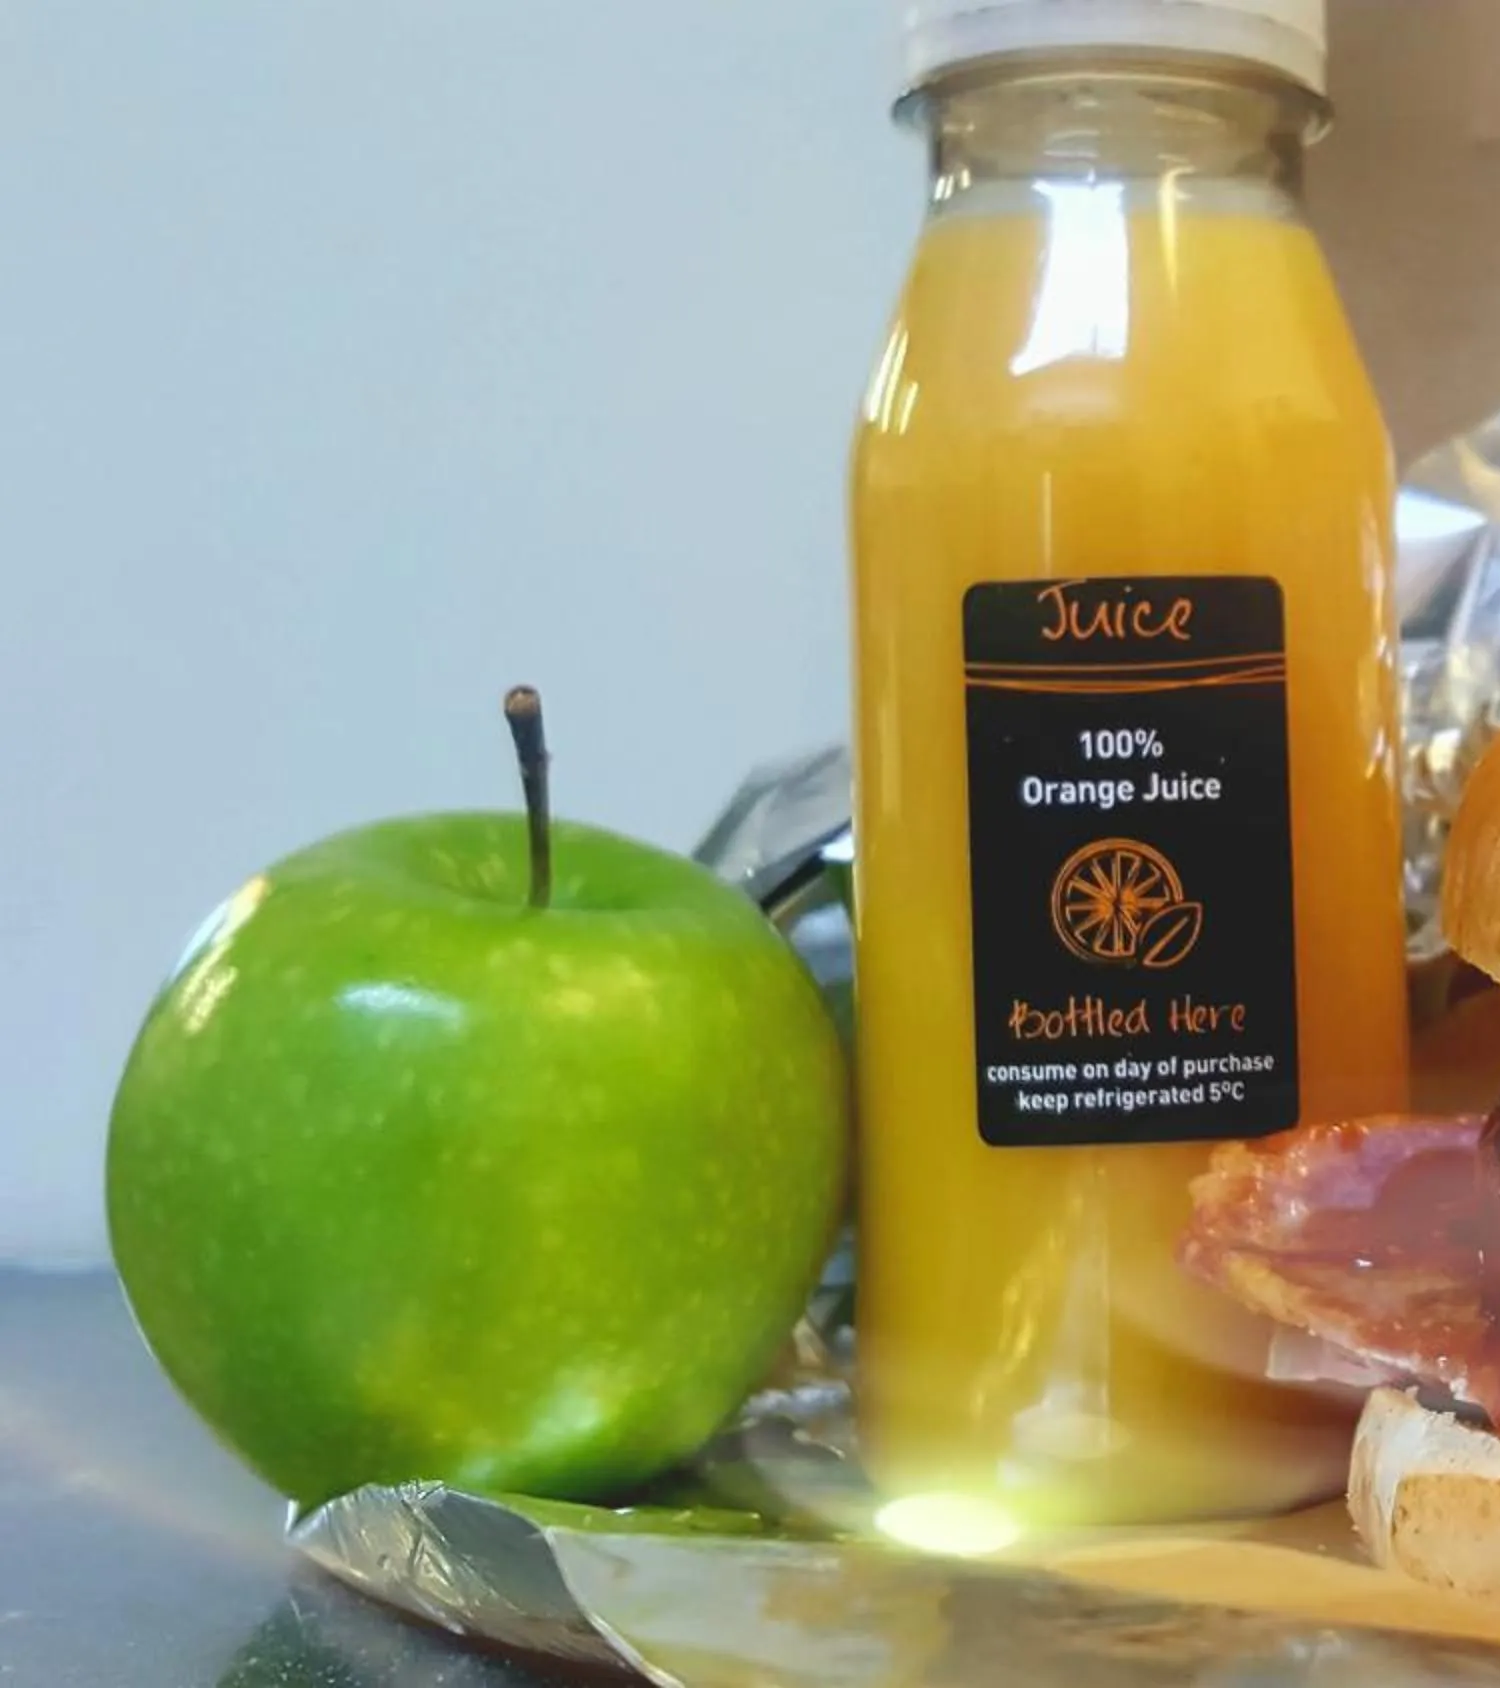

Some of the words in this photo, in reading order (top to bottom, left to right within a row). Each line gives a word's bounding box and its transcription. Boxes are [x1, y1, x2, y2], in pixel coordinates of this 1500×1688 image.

[1037, 578, 1193, 641] Juice
[1079, 729, 1164, 760] 100%
[1021, 776, 1135, 809] Orange
[1142, 771, 1221, 802] Juice
[1008, 995, 1150, 1039] Bottled
[1169, 994, 1246, 1033] Here
[987, 1063, 1078, 1083] consume
[1083, 1063, 1109, 1079] on
[1114, 1058, 1151, 1082] day
[1157, 1055, 1177, 1076] of
[1183, 1053, 1274, 1079] purchase
[1018, 1090, 1069, 1113] keep
[1074, 1084, 1204, 1111] refrigerated
